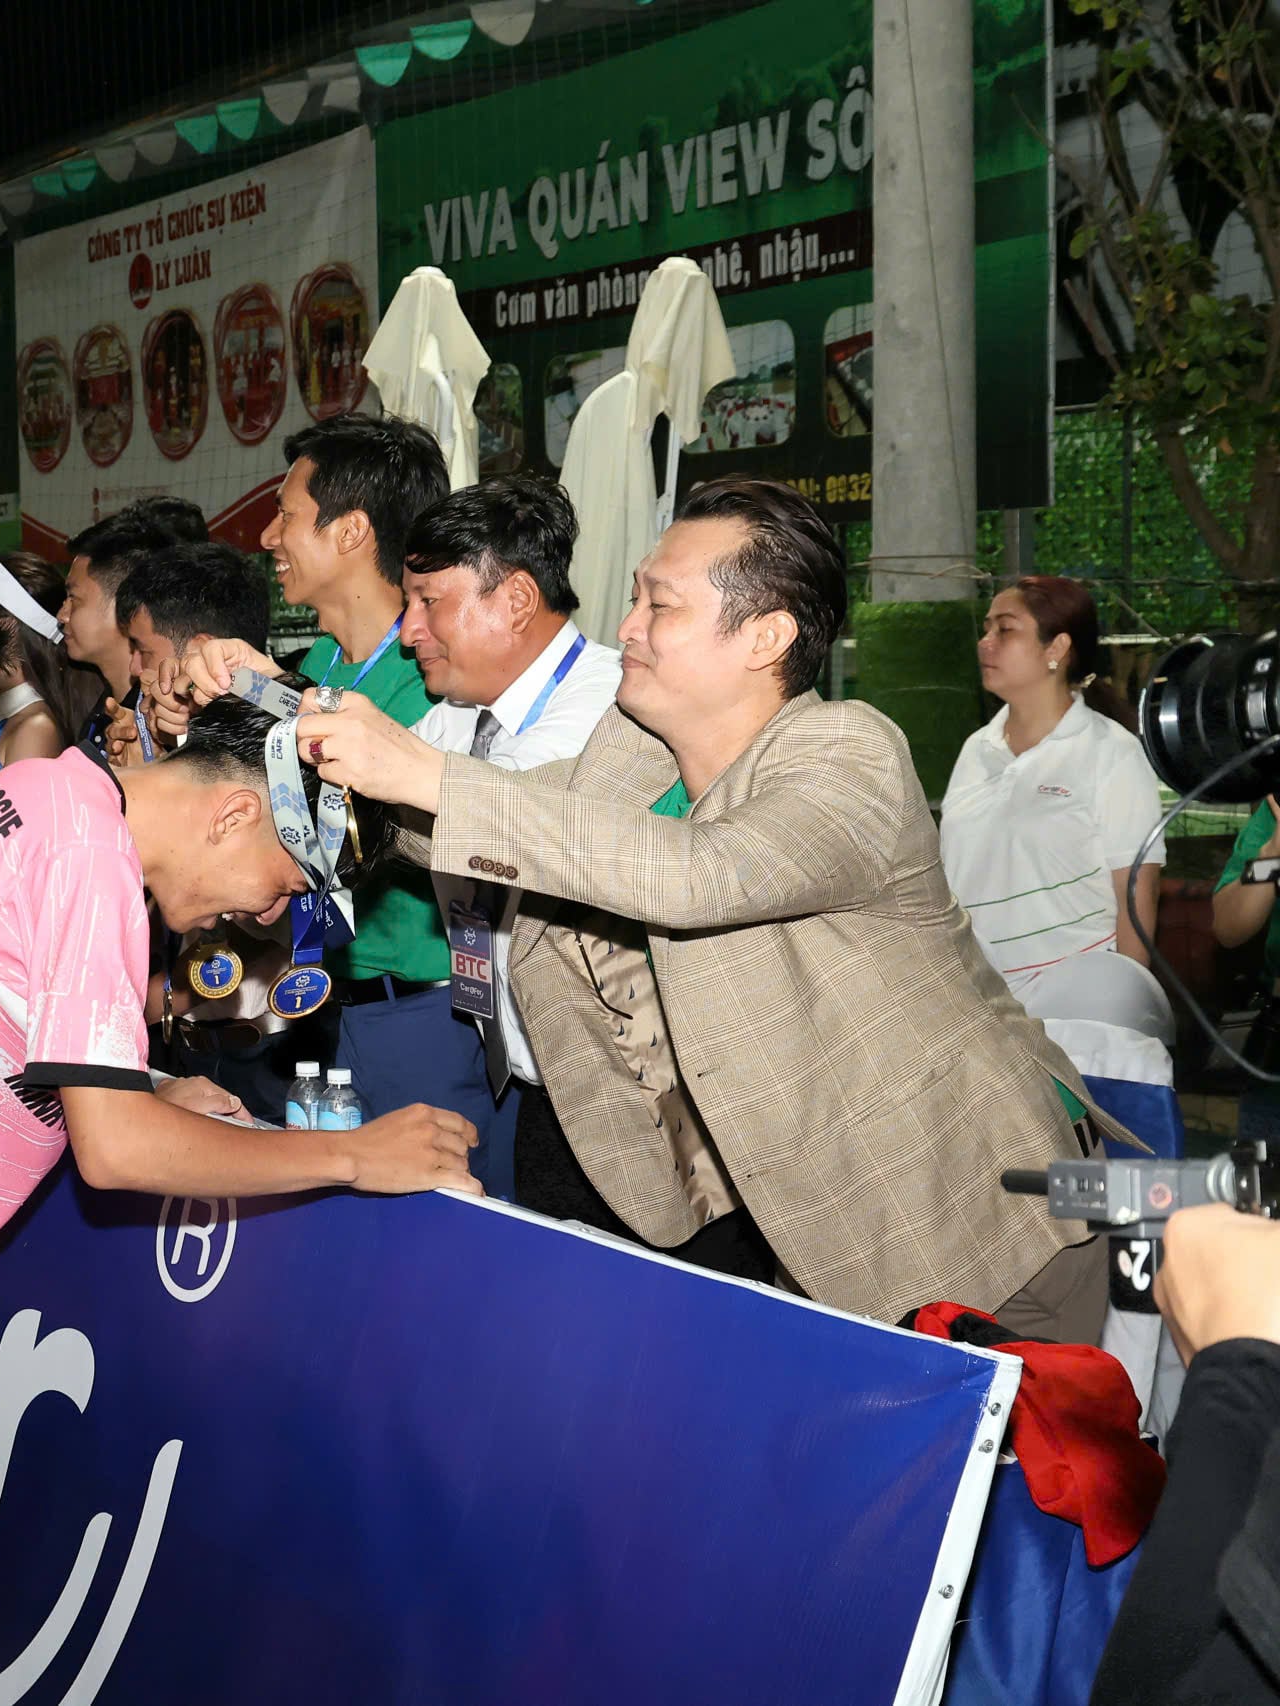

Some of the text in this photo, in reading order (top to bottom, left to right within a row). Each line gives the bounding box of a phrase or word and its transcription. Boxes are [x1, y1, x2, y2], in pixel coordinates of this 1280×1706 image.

[424, 65, 873, 265] VIVA QUÁN VIEW SÔ
[124, 223, 141, 252] TY
[495, 290, 536, 328] Cơm
[544, 278, 579, 320] văn
[456, 953, 487, 980] BTC
[294, 996, 302, 1009] 1
